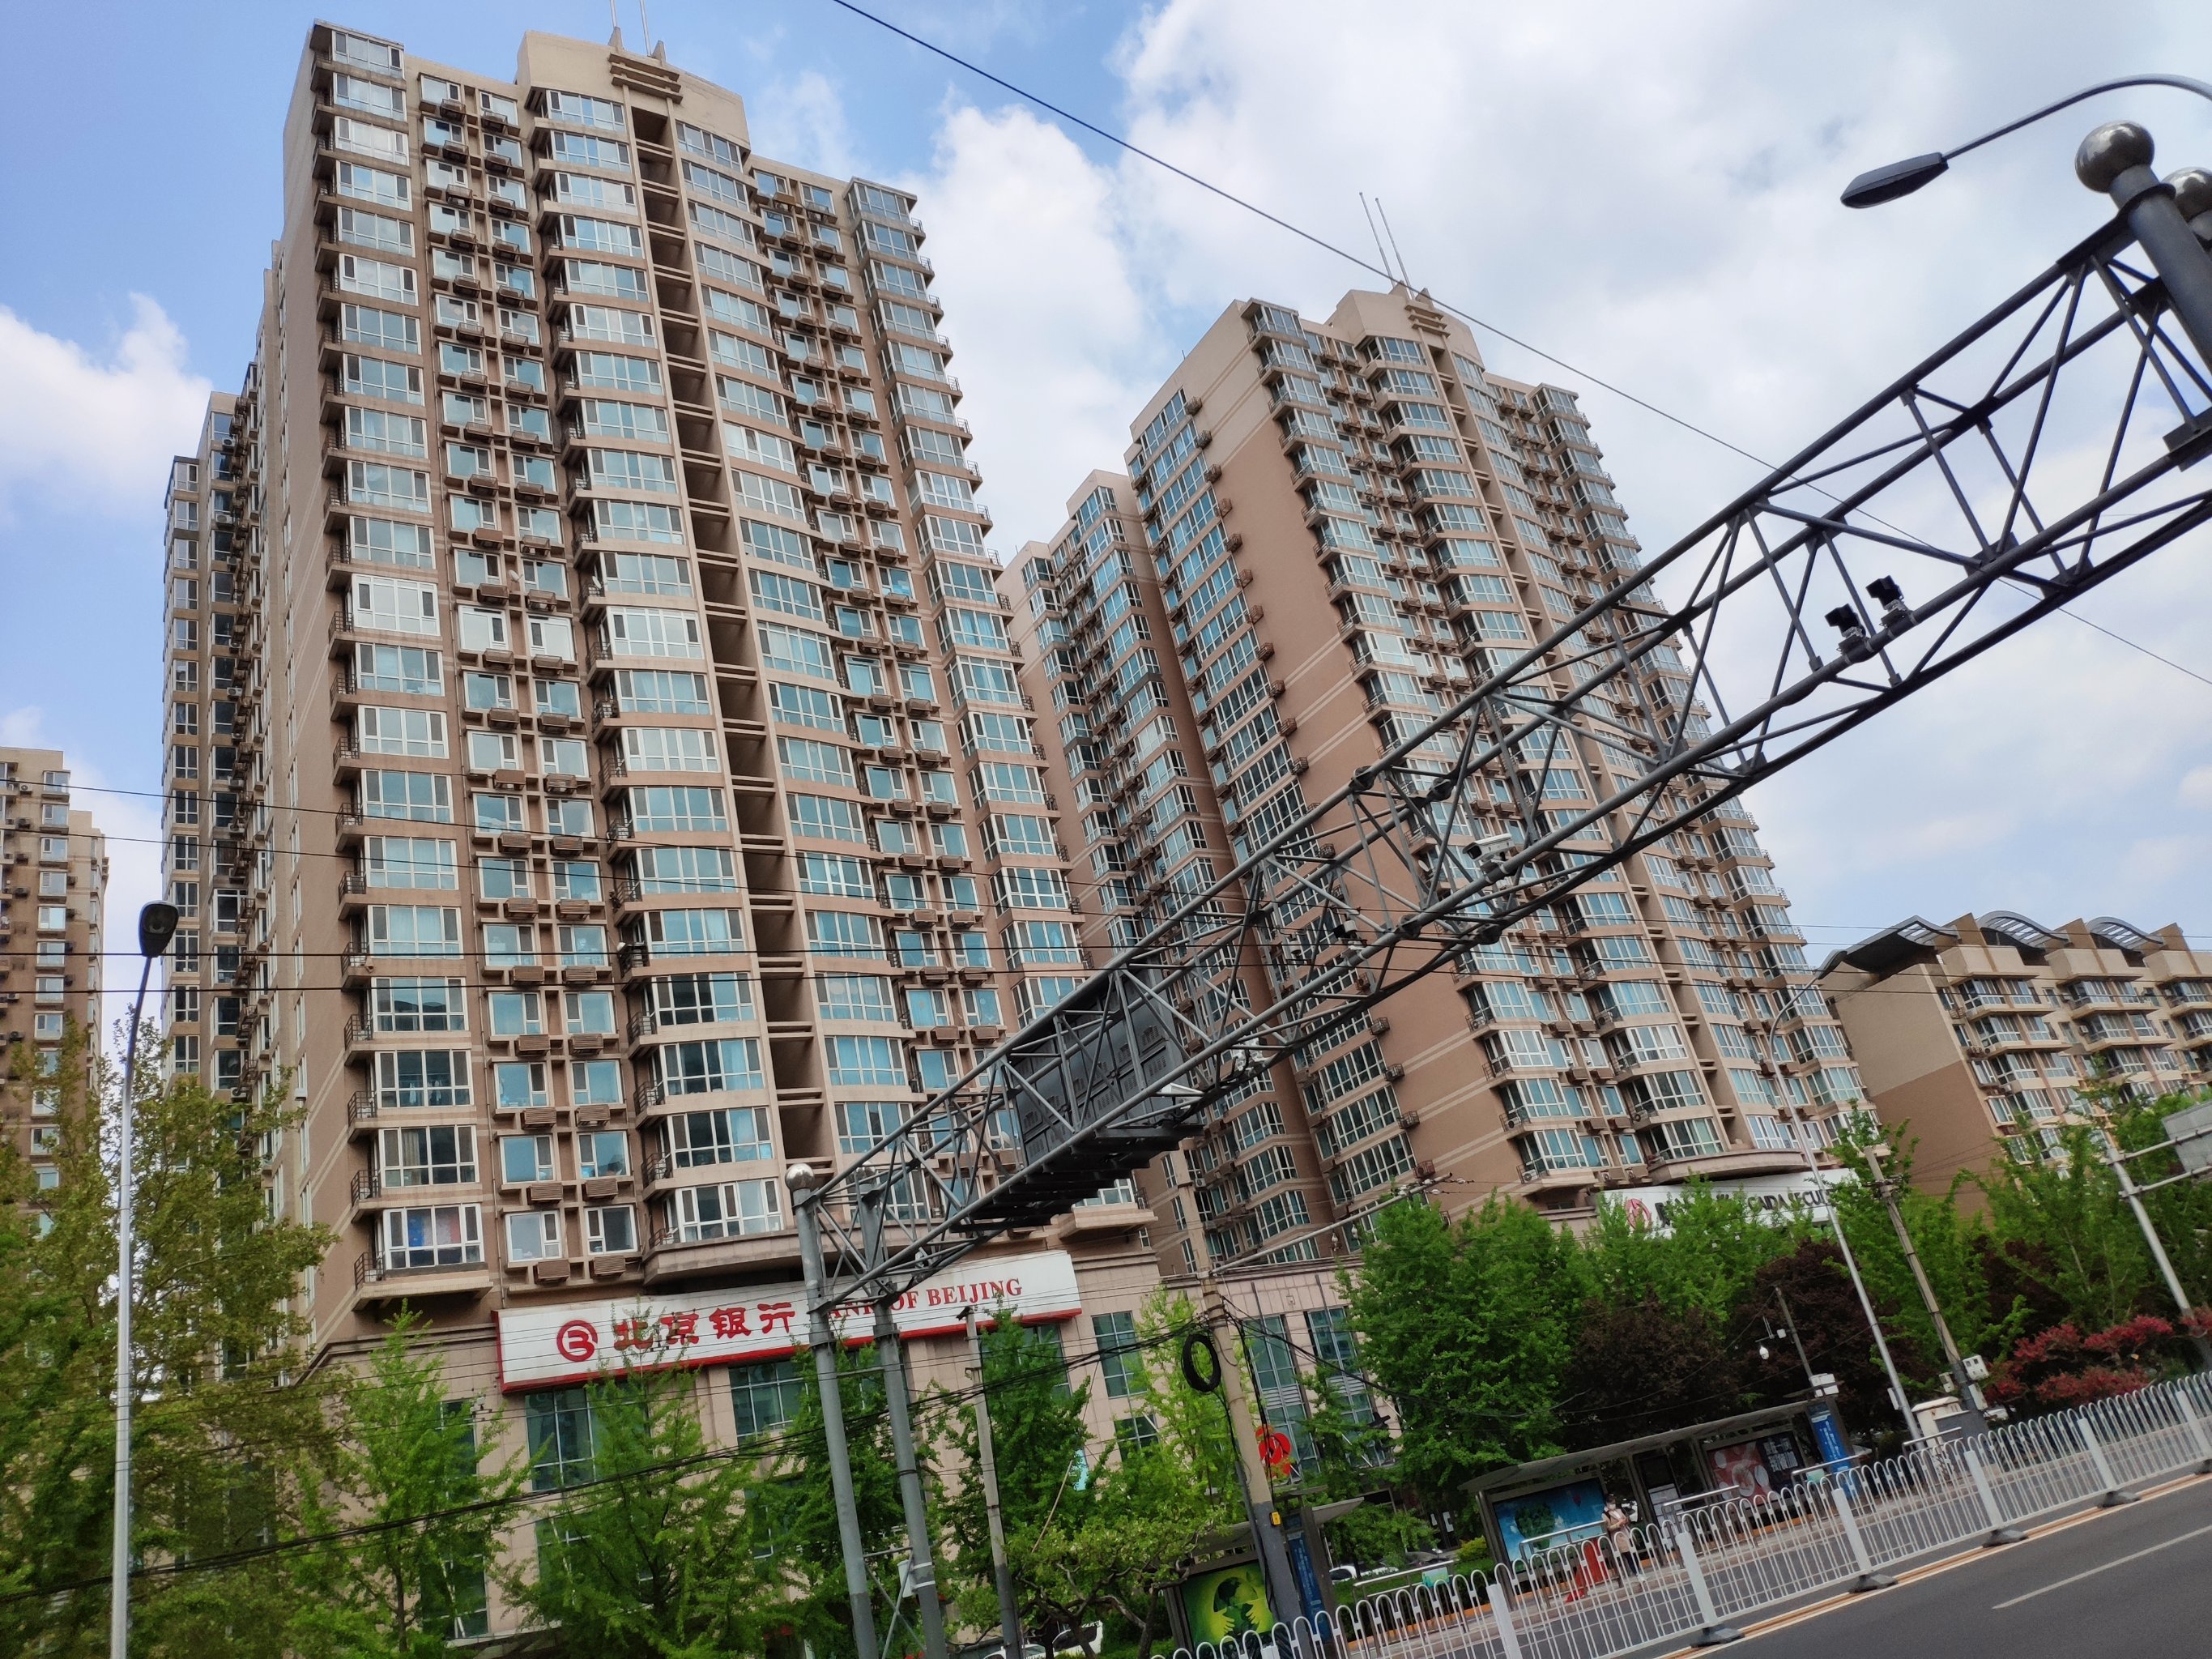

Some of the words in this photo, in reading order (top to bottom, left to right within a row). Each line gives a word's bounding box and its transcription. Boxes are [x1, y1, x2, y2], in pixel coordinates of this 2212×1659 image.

[926, 1278, 1022, 1307] BEIJING
[613, 1302, 795, 1350] 北京银行
